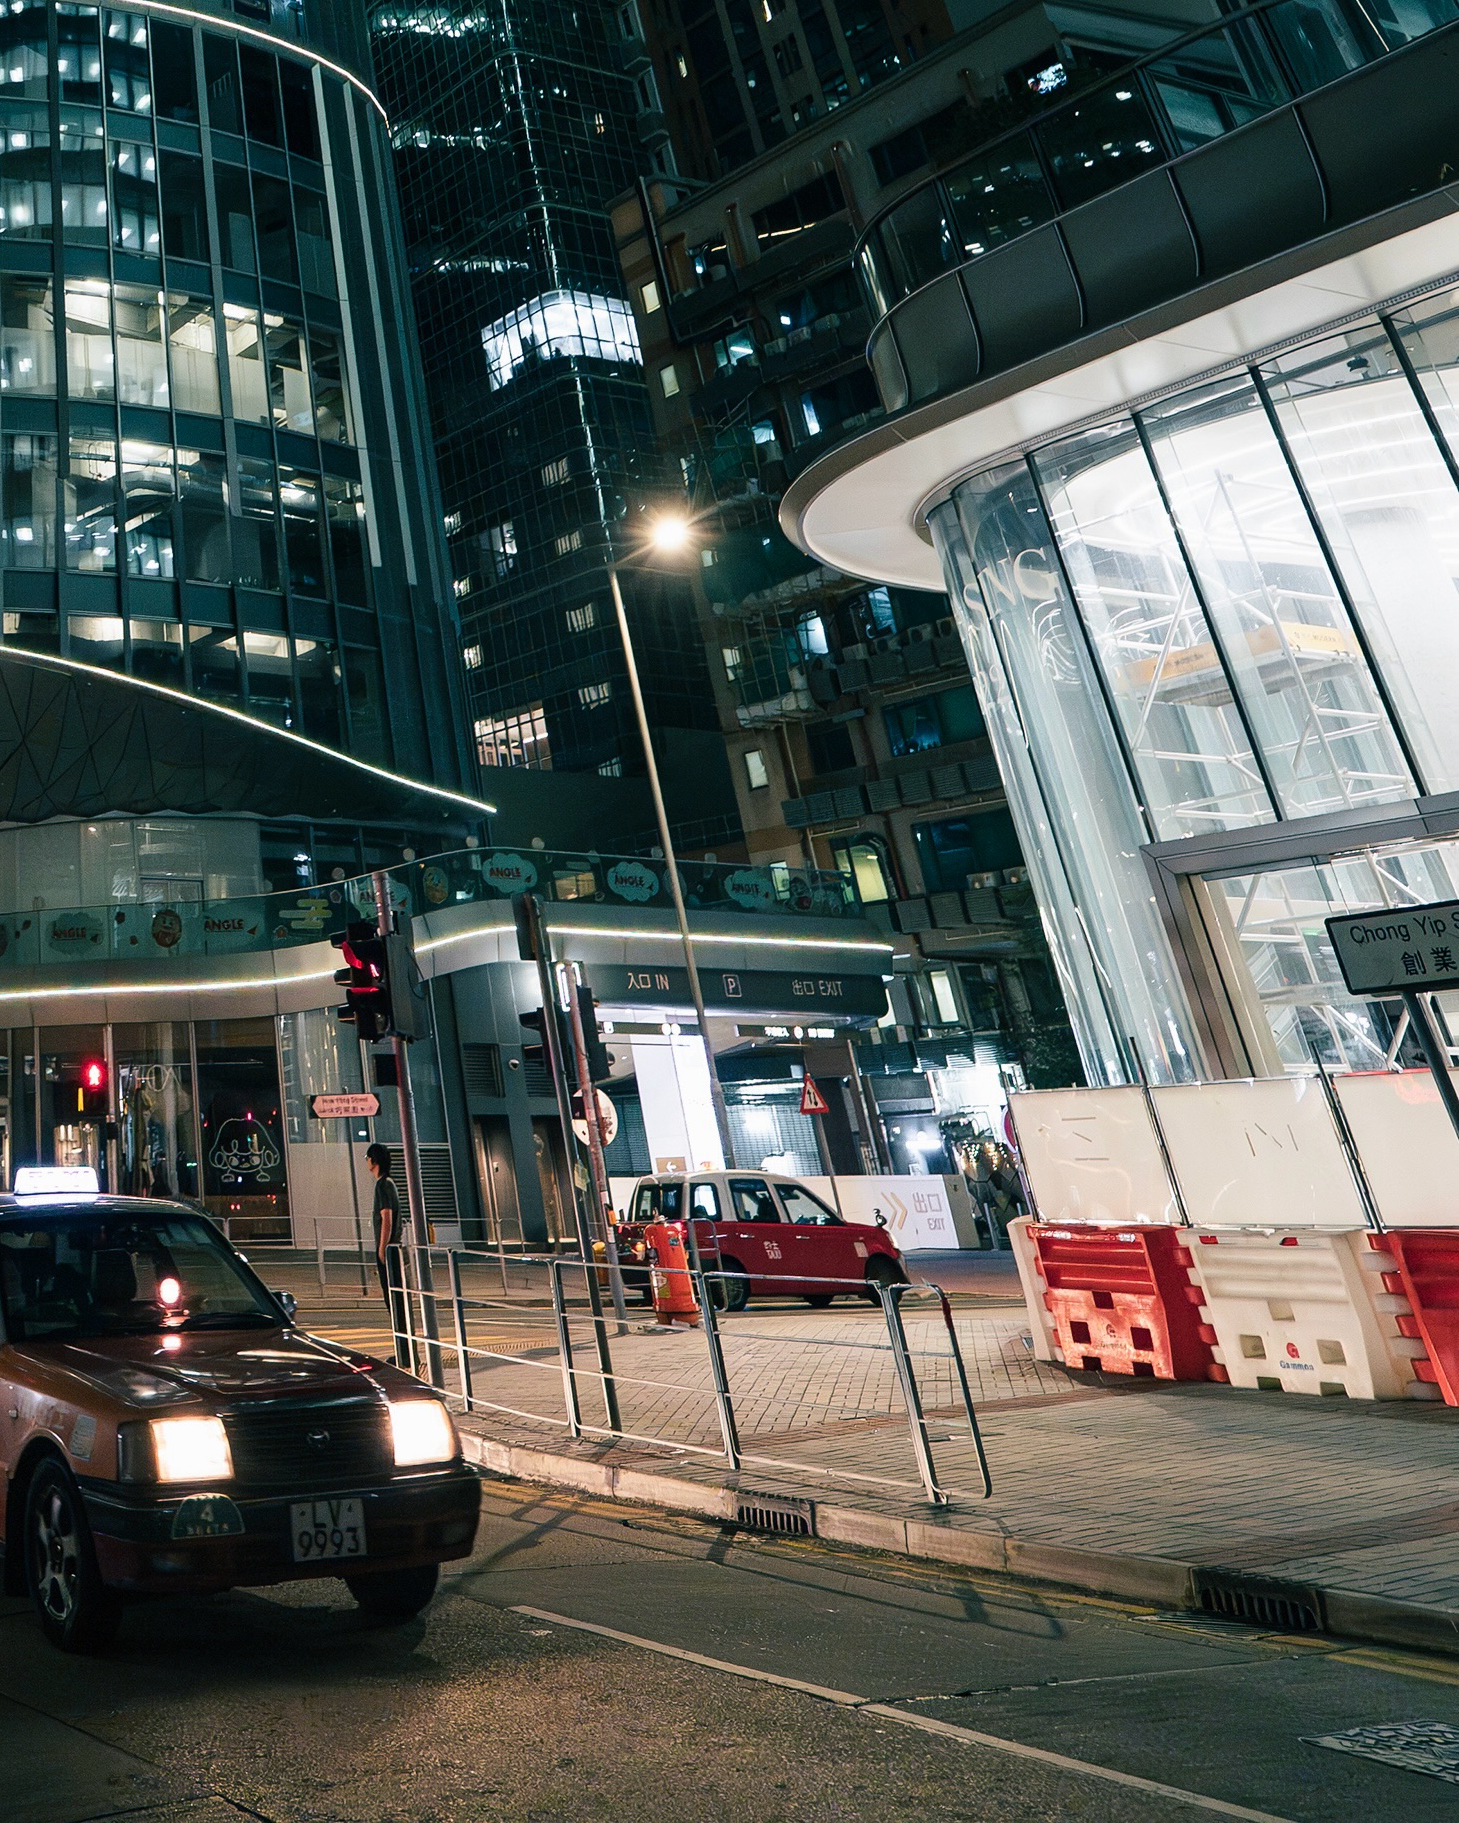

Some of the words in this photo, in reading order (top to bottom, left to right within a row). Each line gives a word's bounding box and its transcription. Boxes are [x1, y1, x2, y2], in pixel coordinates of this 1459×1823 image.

[1350, 924, 1411, 945] Chong
[1413, 916, 1446, 937] Yip
[1401, 946, 1458, 976] 創業
[628, 972, 651, 990] 入口
[655, 974, 670, 990] IN
[792, 980, 815, 996] 出口
[818, 980, 843, 997] EXIT
[912, 1191, 942, 1213] 出口
[311, 1499, 343, 1530] LV
[298, 1526, 361, 1558] 9993
